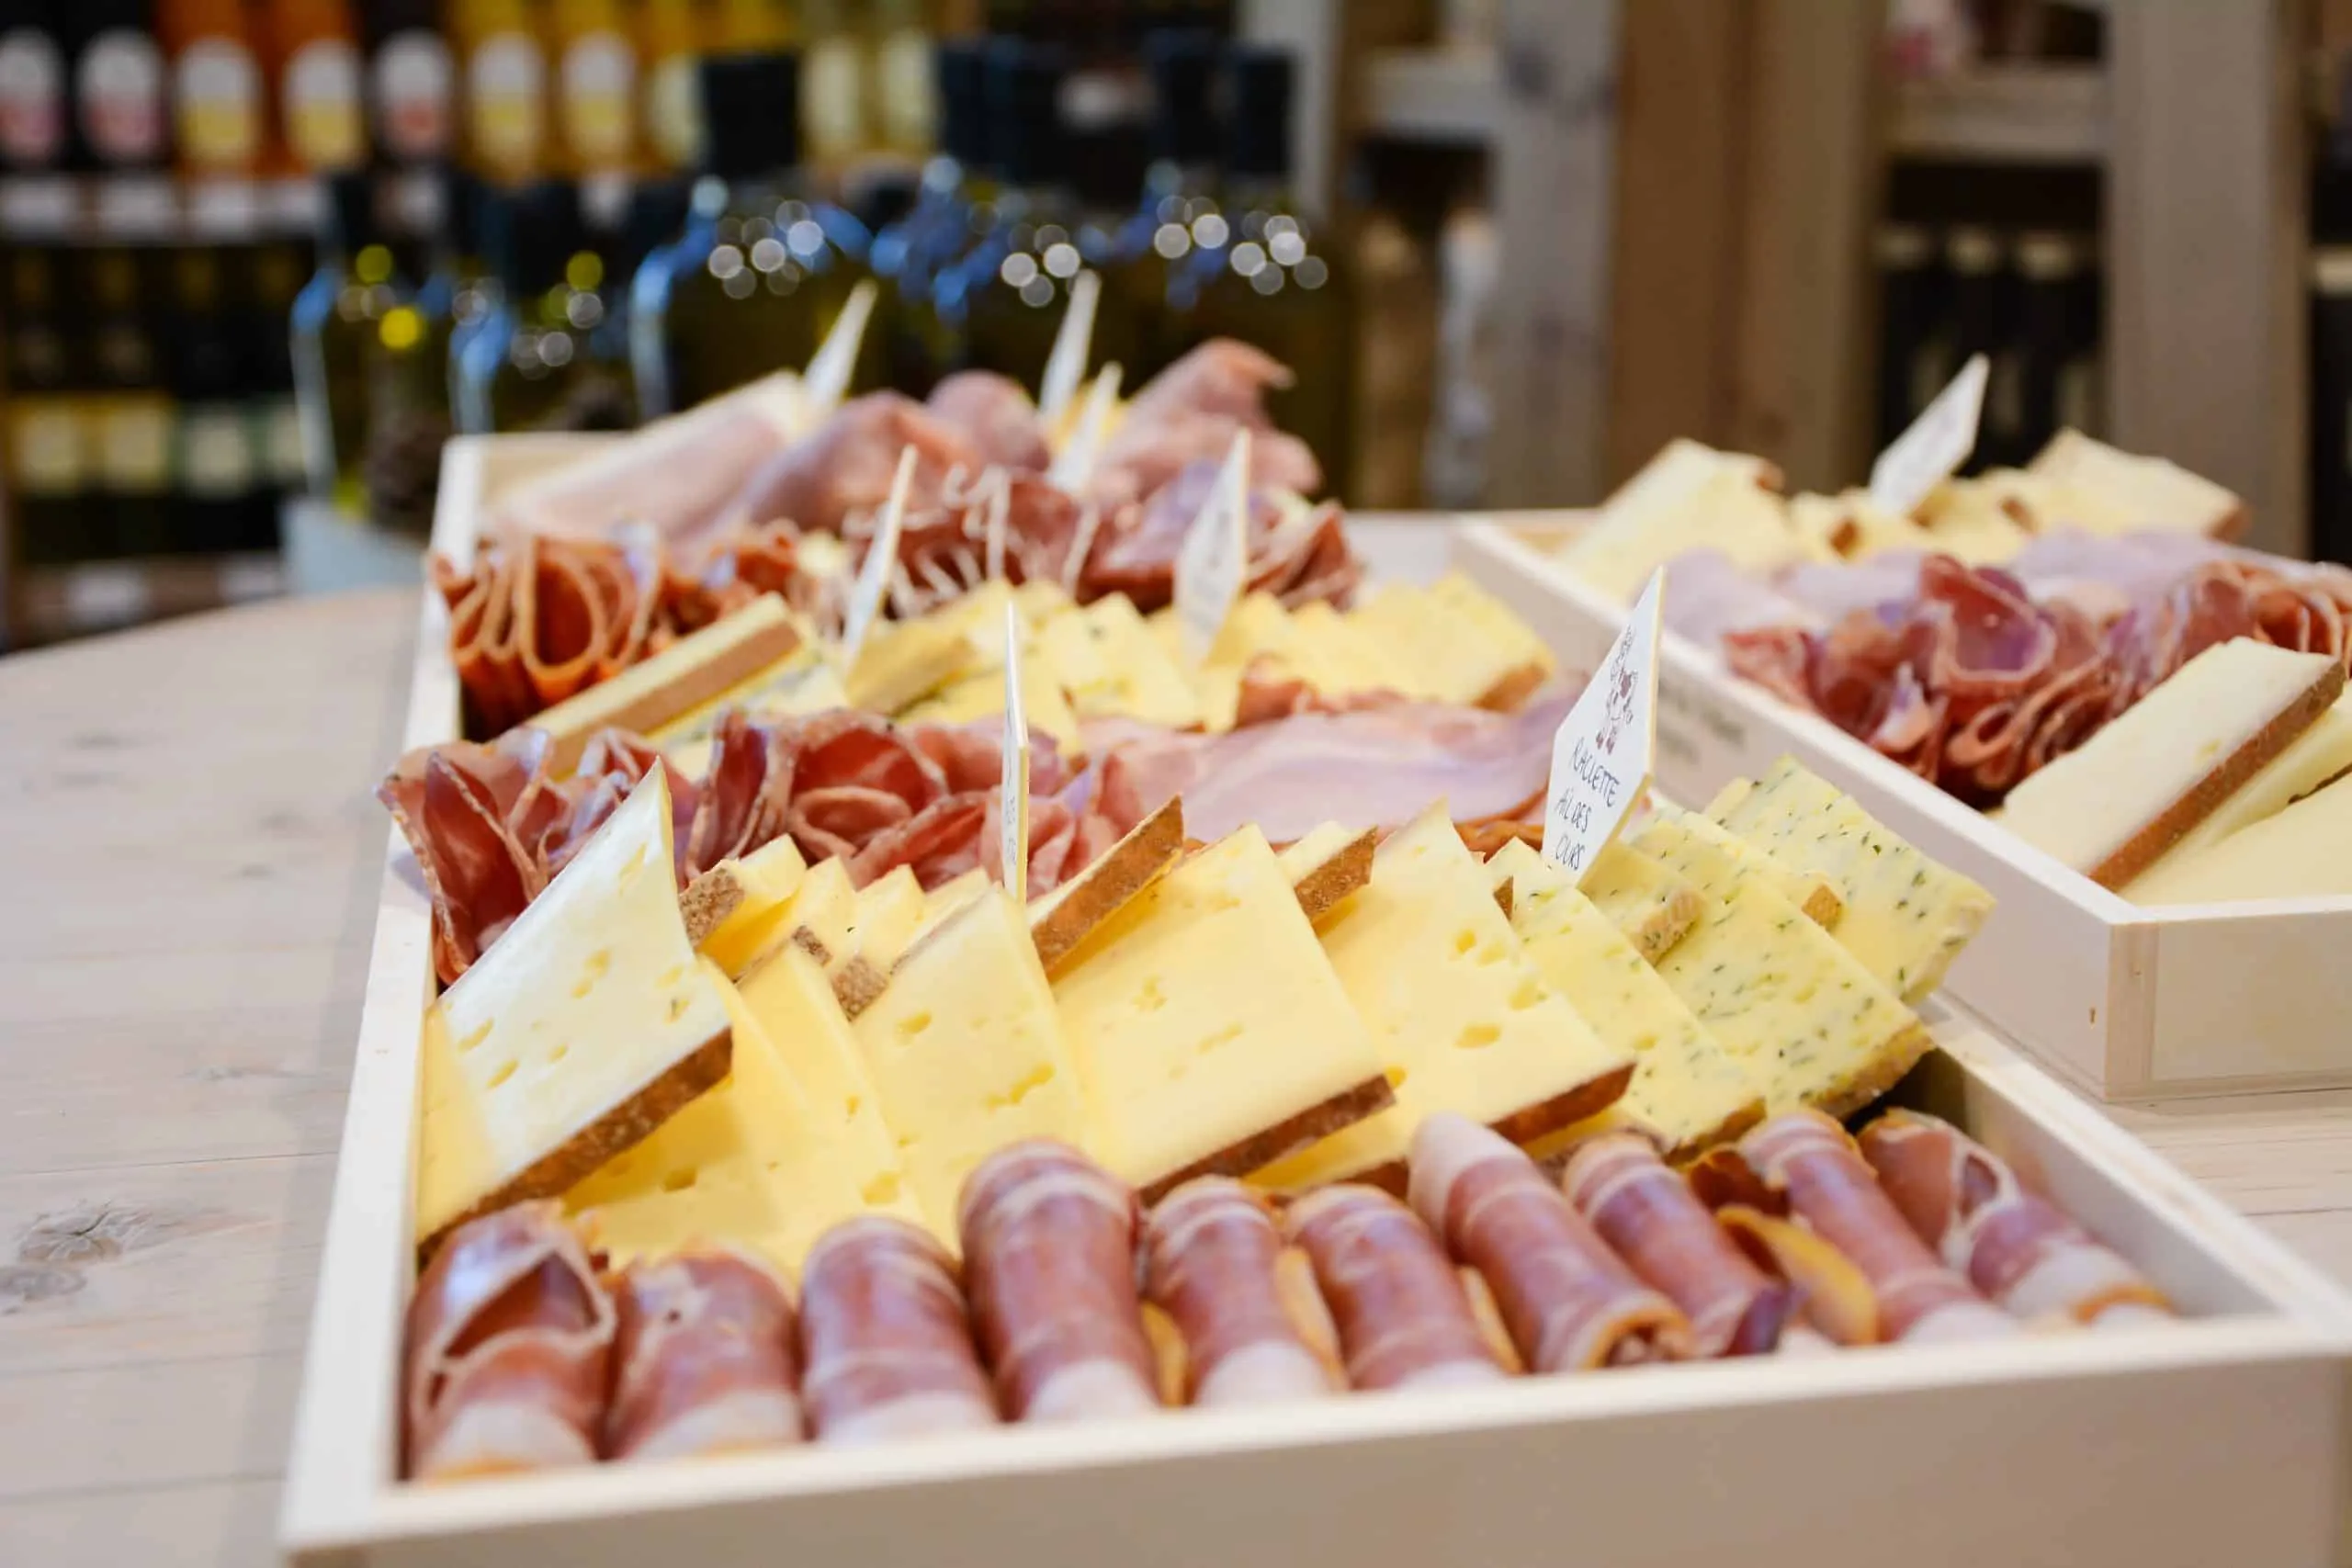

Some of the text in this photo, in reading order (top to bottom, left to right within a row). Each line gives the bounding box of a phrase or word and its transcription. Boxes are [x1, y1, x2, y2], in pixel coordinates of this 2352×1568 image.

[1569, 737, 1620, 807] RACLETTE
[1571, 801, 1592, 833] DES
[1555, 833, 1586, 871] OURS
